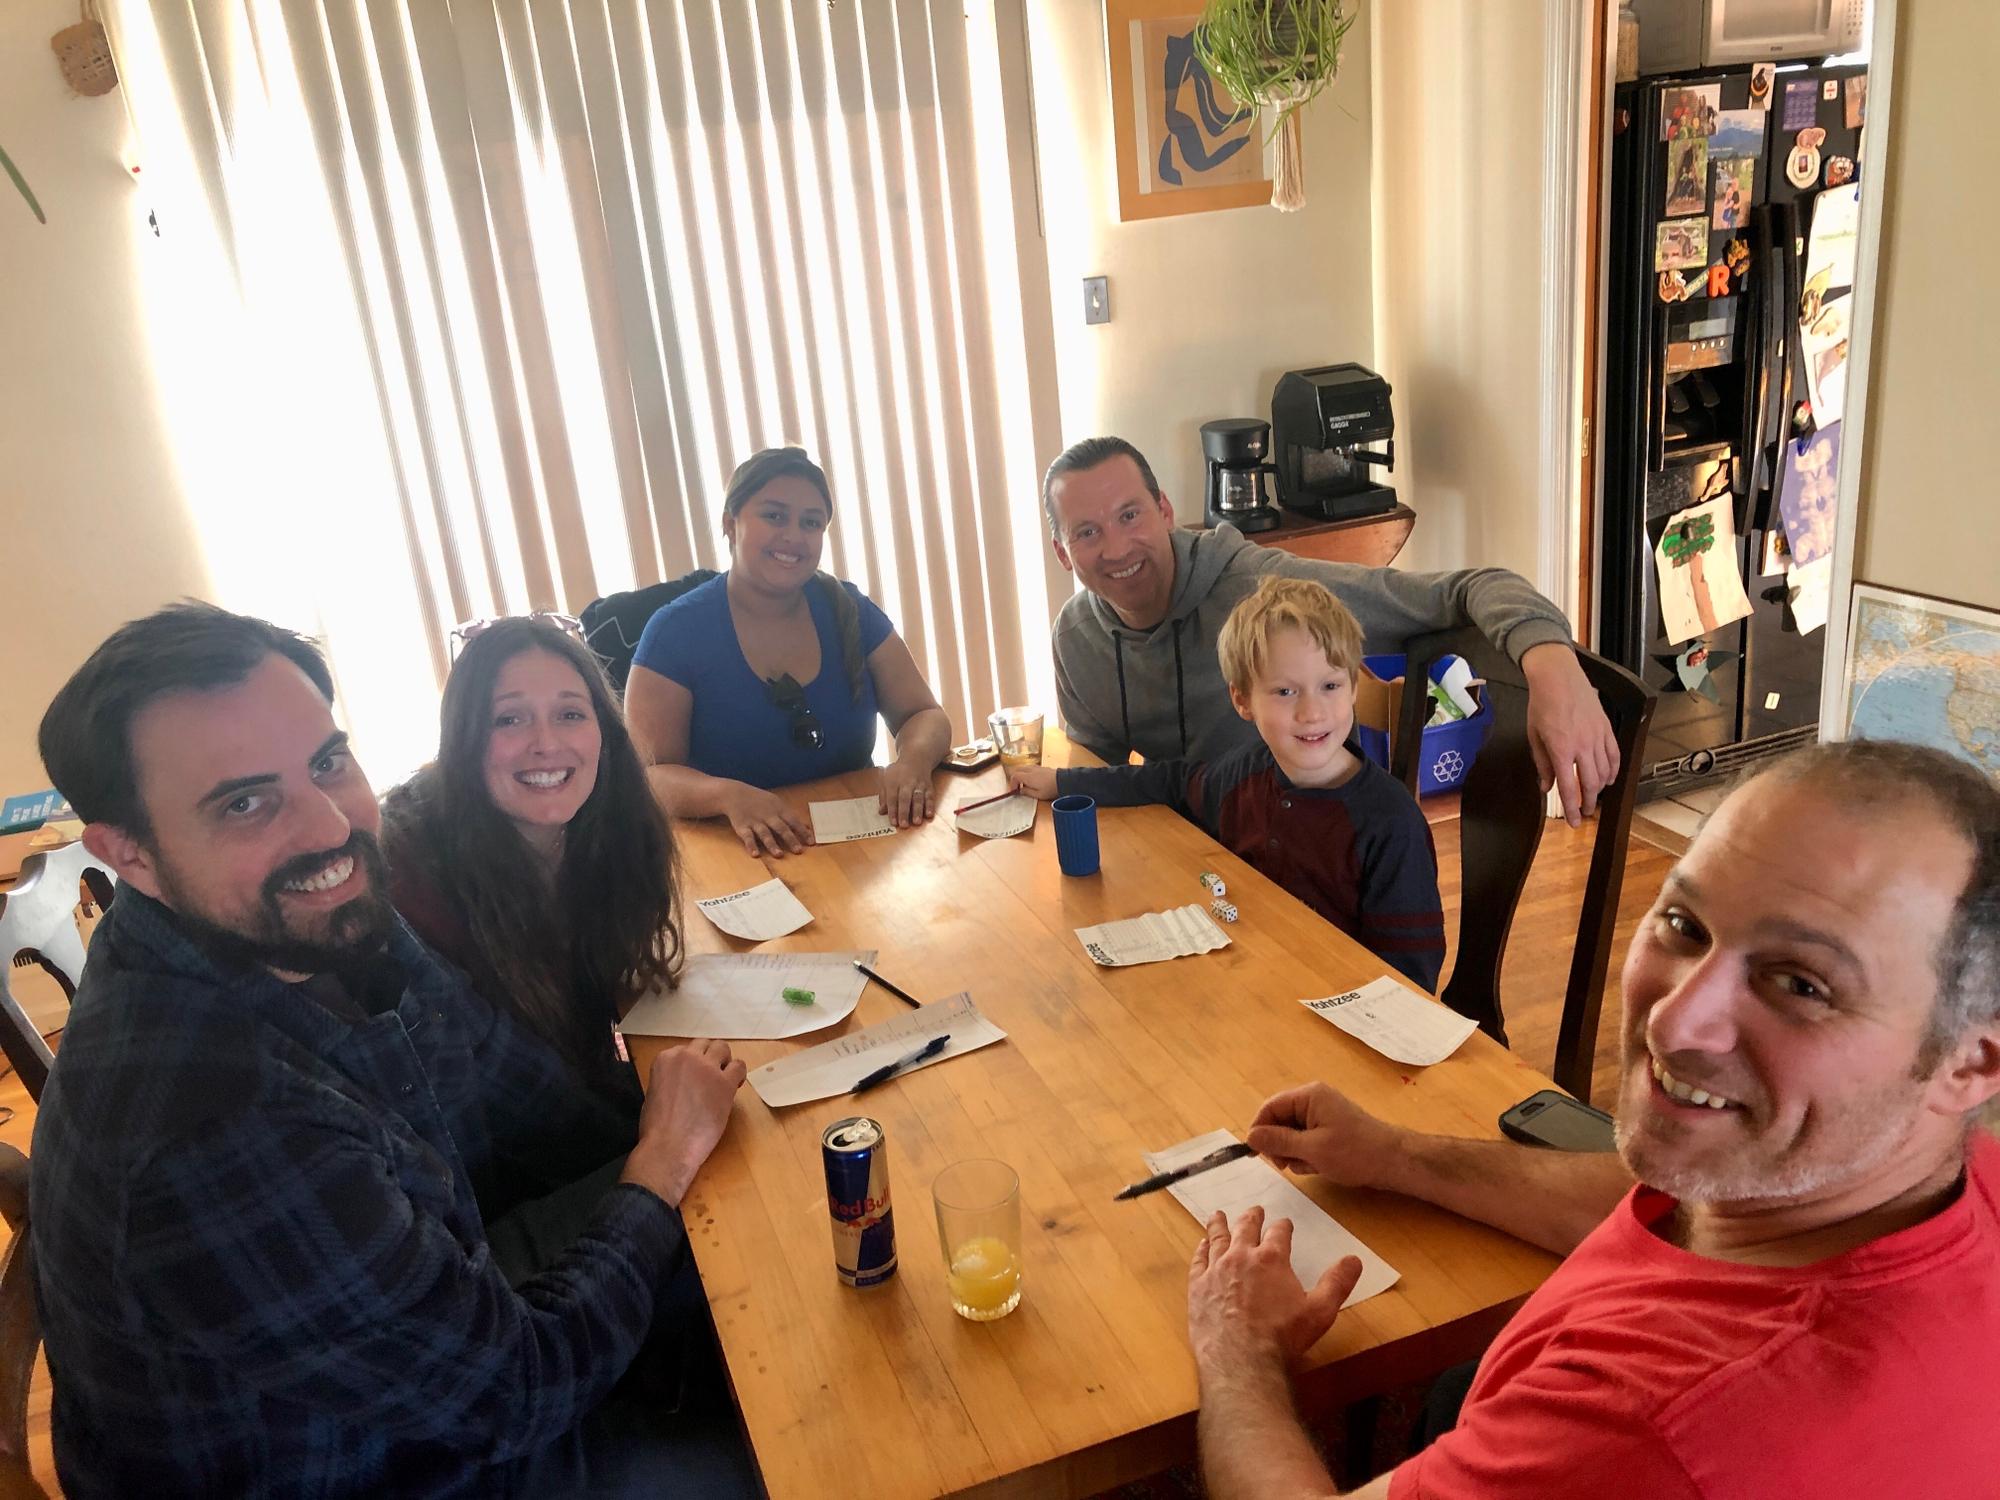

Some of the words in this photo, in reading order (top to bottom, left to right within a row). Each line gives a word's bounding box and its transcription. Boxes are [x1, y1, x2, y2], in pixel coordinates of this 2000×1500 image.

[1708, 265, 1730, 297] R
[698, 890, 752, 907] Yahtzee
[1086, 942, 1118, 965] ahtzee
[1304, 991, 1362, 1010] Yahtzee
